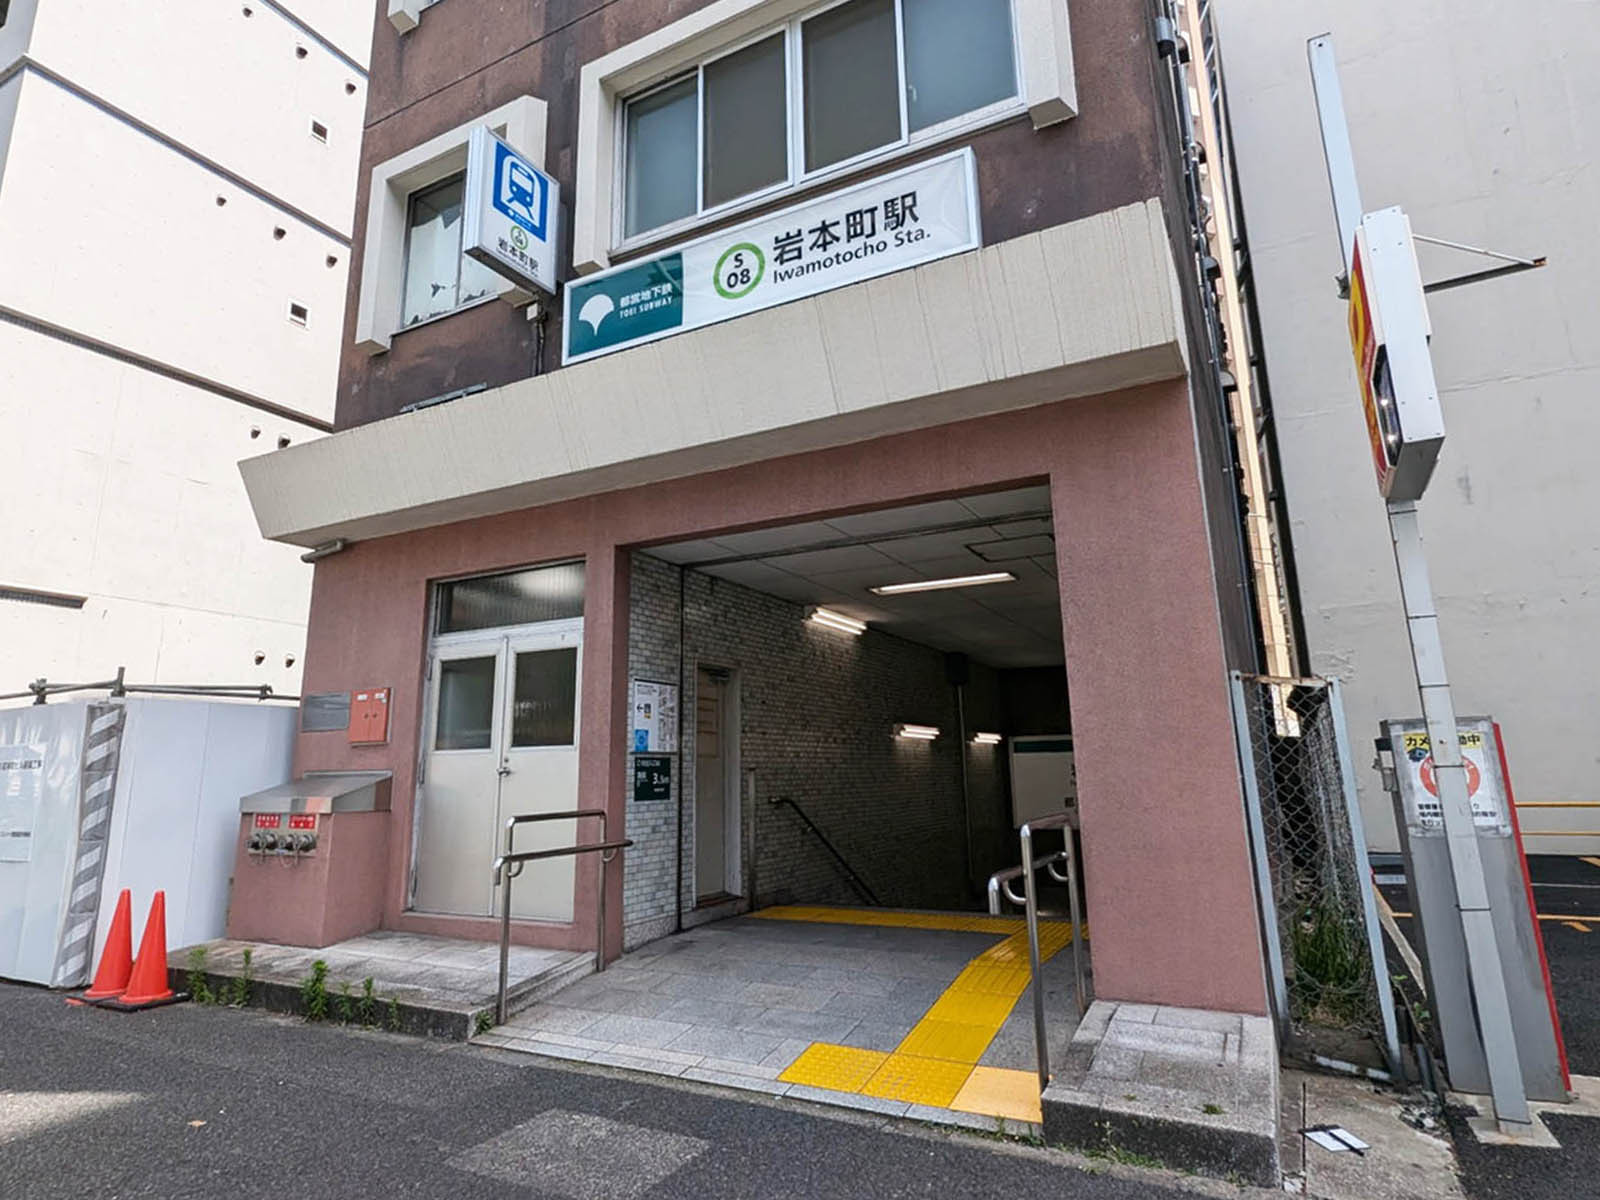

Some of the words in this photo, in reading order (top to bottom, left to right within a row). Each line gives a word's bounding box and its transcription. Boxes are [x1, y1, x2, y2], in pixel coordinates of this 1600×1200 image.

[773, 190, 919, 266] 岩本町駅
[734, 253, 743, 268] S
[773, 240, 887, 284] Iwamotocho
[894, 228, 931, 247] Sta.
[727, 268, 751, 288] 08
[620, 283, 672, 308] 都営地下鉄
[620, 306, 637, 319] TOEI
[639, 295, 672, 312] SUBWAY
